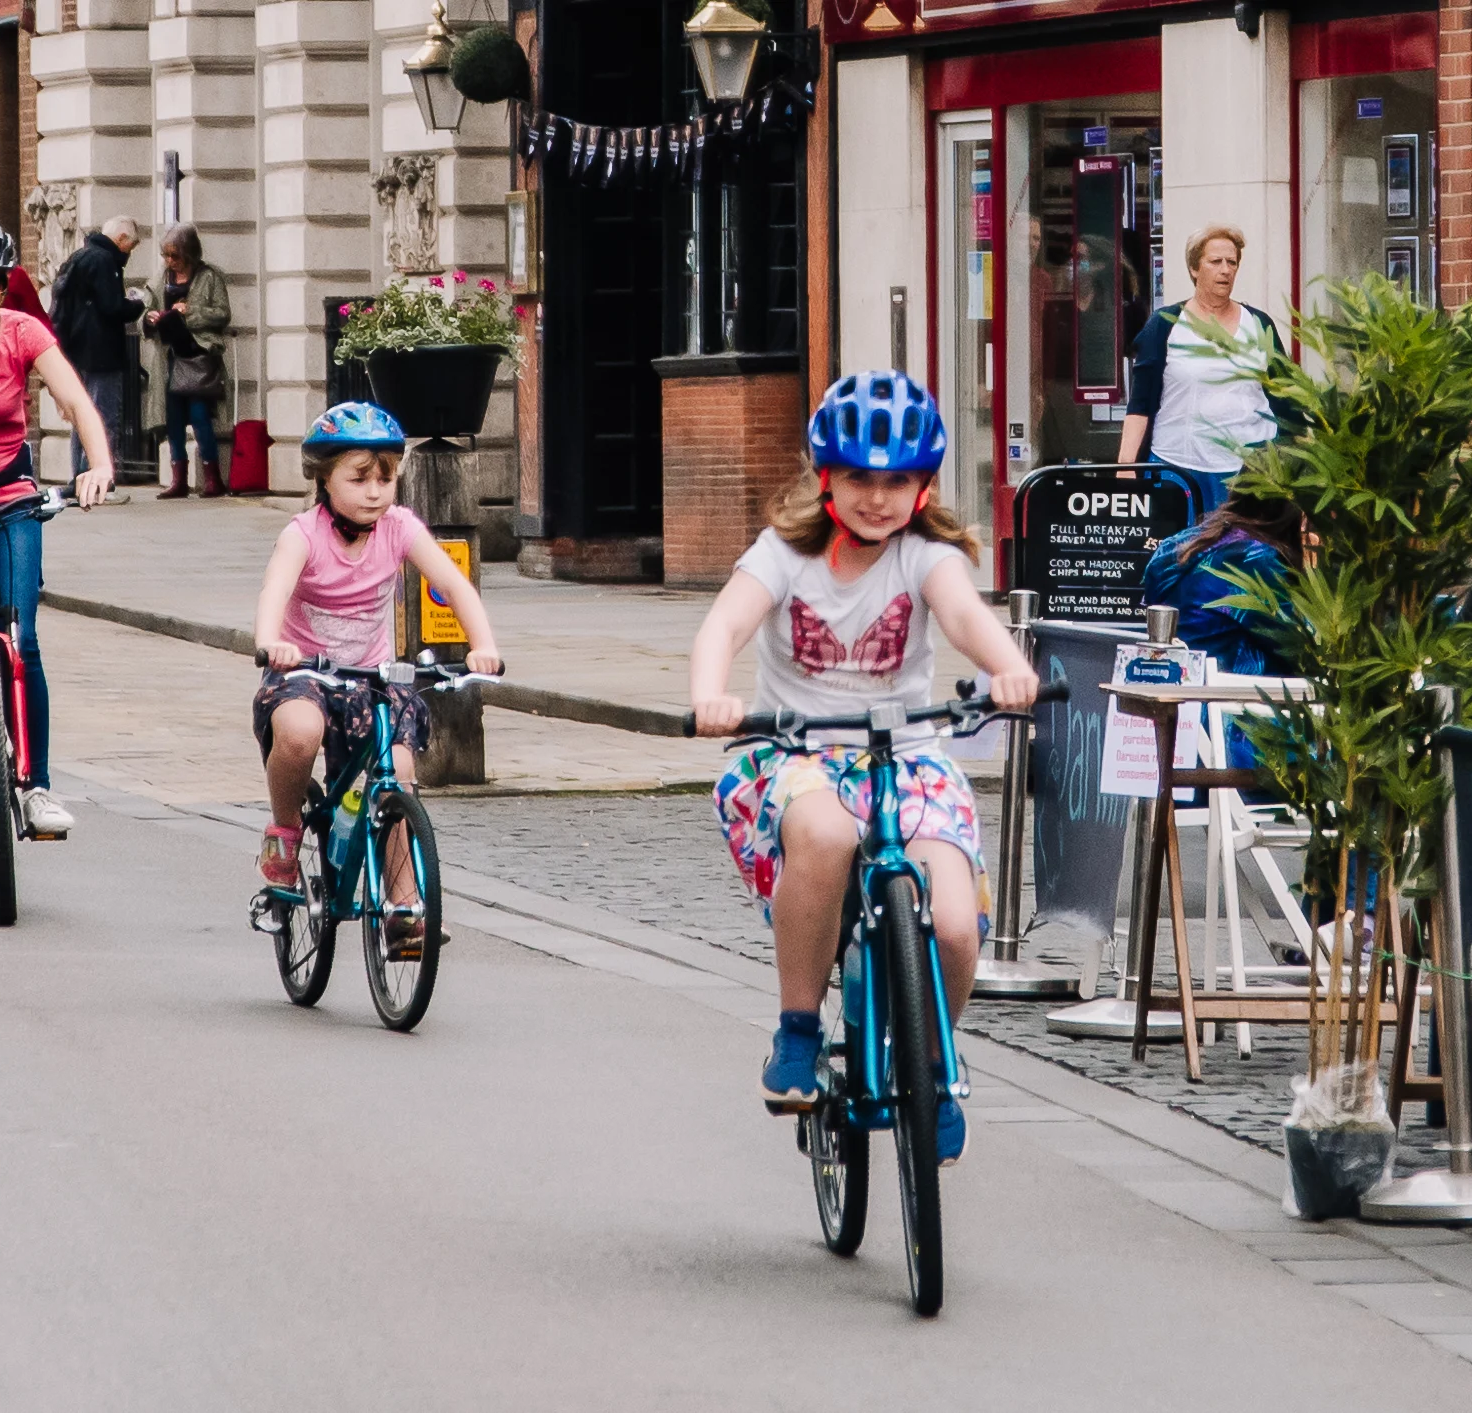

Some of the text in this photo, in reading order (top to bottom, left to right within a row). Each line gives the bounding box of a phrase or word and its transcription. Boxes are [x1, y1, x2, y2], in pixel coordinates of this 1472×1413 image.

[1068, 493, 1151, 518] OPEN
[1050, 524, 1151, 537] FULL BREAKFAST
[1050, 535, 1085, 544] SERVED
[1108, 537, 1126, 545] DAY
[1049, 559, 1135, 570] COD OR HADDOCK
[1049, 568, 1079, 577] CHIPS
[1049, 595, 1076, 604] LIVER
[1079, 596, 1098, 605] AND
[1100, 596, 1131, 605] BACON
[1073, 605, 1114, 615] POTATOES
[1116, 607, 1132, 616] AND
[435, 620, 457, 628] local
[433, 630, 459, 639] buses
[1141, 666, 1170, 680] smoking
